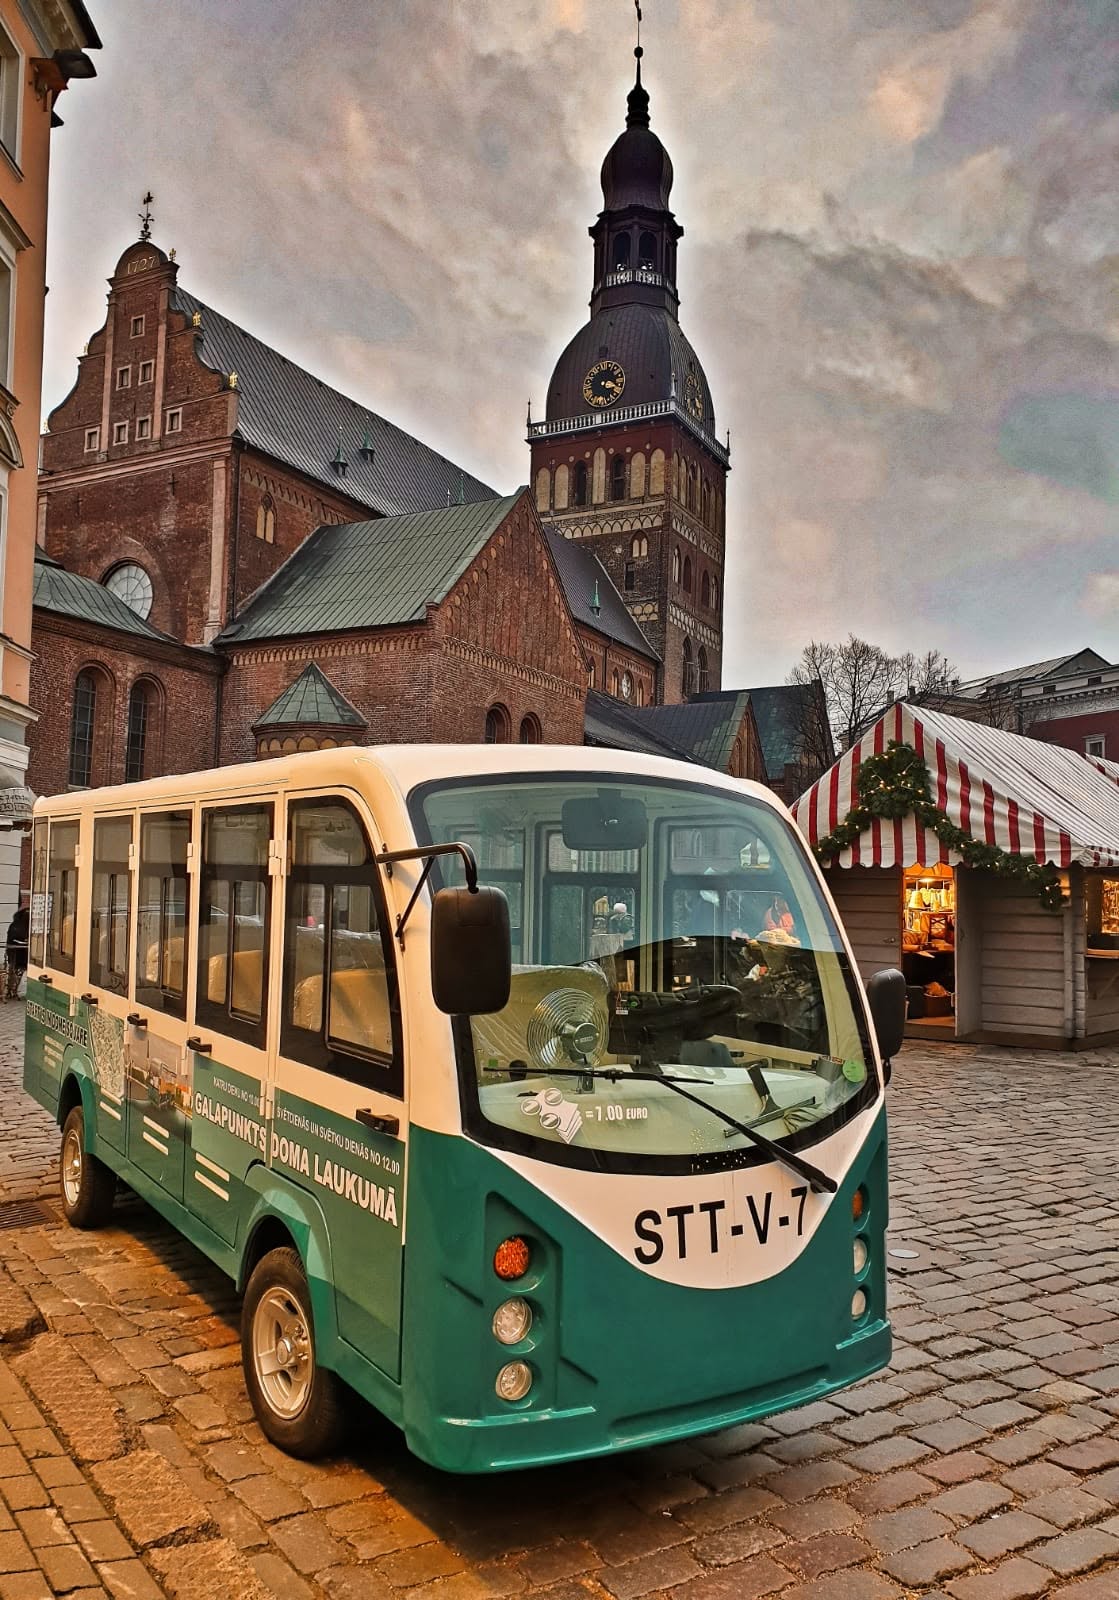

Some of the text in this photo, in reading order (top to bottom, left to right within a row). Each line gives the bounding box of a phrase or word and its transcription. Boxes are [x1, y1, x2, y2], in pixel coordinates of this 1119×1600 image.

[127, 255, 156, 275] 1727
[625, 1107, 648, 1120] EURO
[194, 1092, 399, 1228] GALAPUNKTS DOMA LAUKUMĀ
[310, 1123, 319, 1137] UN
[319, 1127, 344, 1148] SVĒTKU
[345, 1138, 369, 1161] DIENĀS
[370, 1149, 381, 1166] NO
[381, 1155, 400, 1175] 12.00
[634, 1186, 808, 1265] STT-V-7
